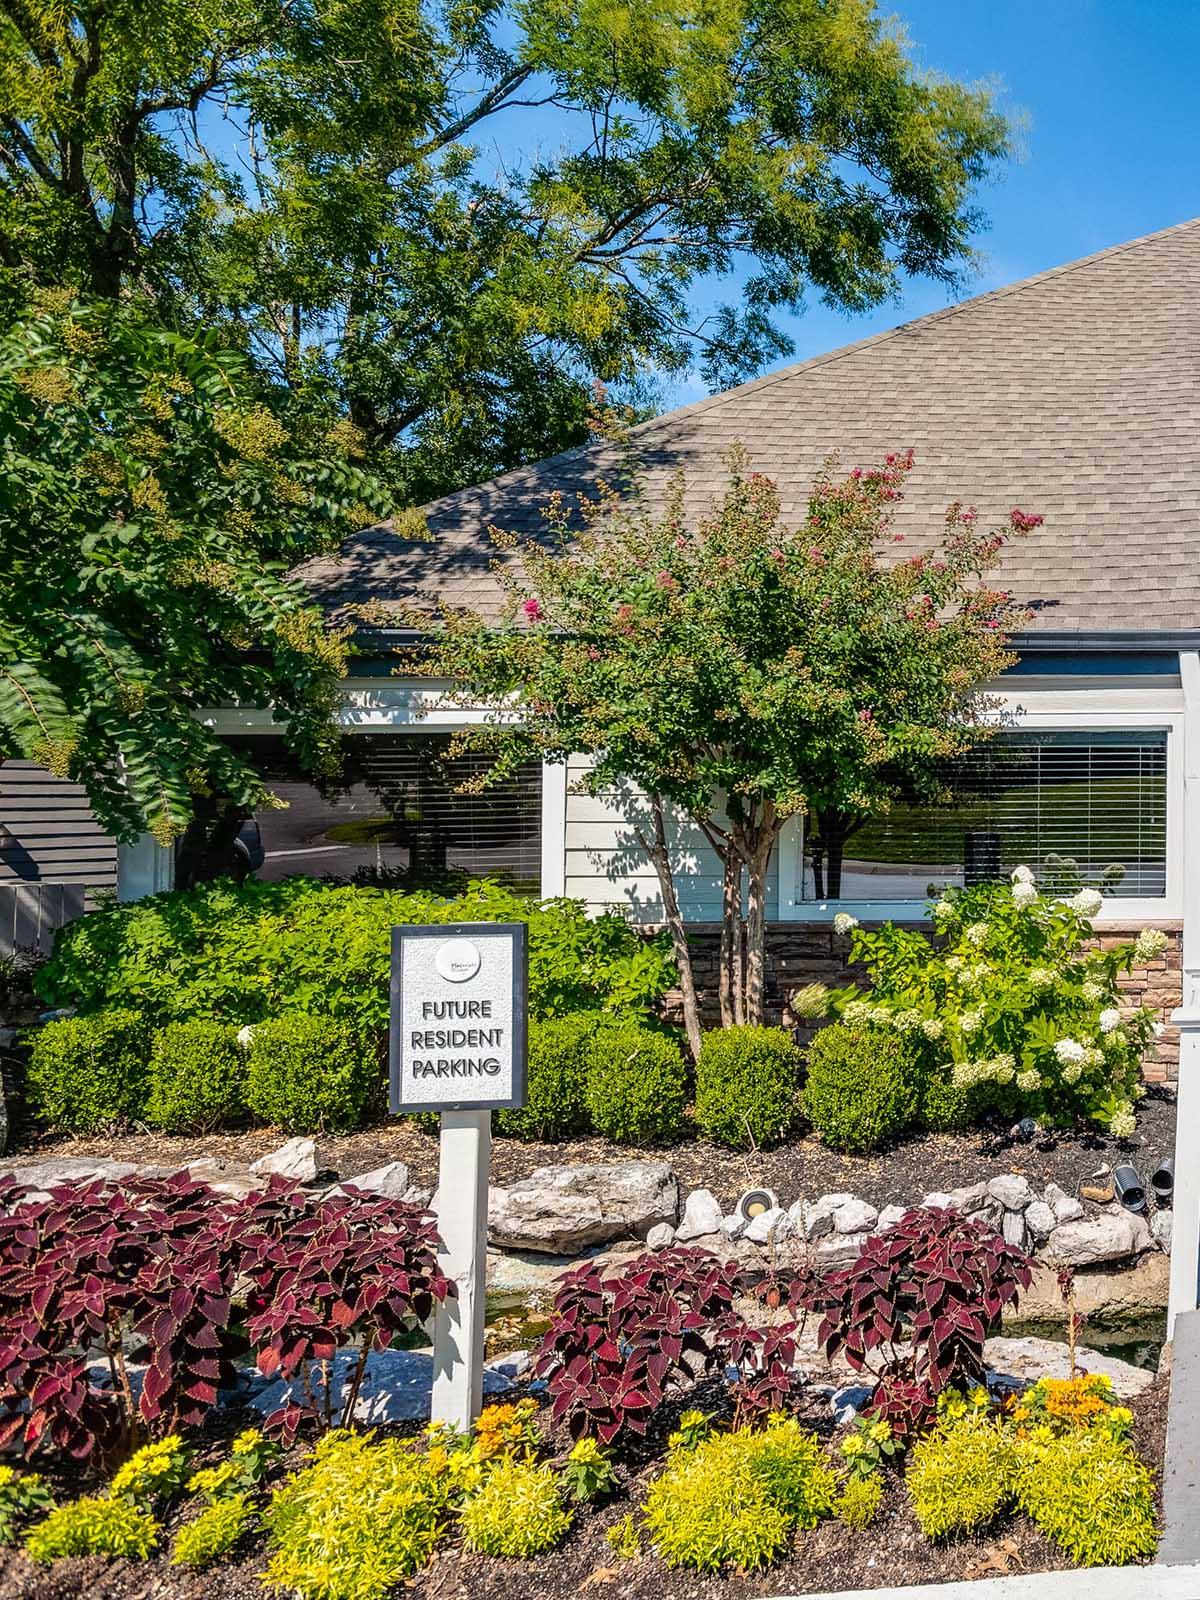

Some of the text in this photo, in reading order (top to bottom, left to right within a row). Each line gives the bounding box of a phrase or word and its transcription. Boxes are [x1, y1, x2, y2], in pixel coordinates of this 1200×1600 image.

[422, 1000, 492, 1020] FUTURE
[411, 1028, 504, 1049] RESIDENT
[412, 1057, 501, 1079] PARKING
